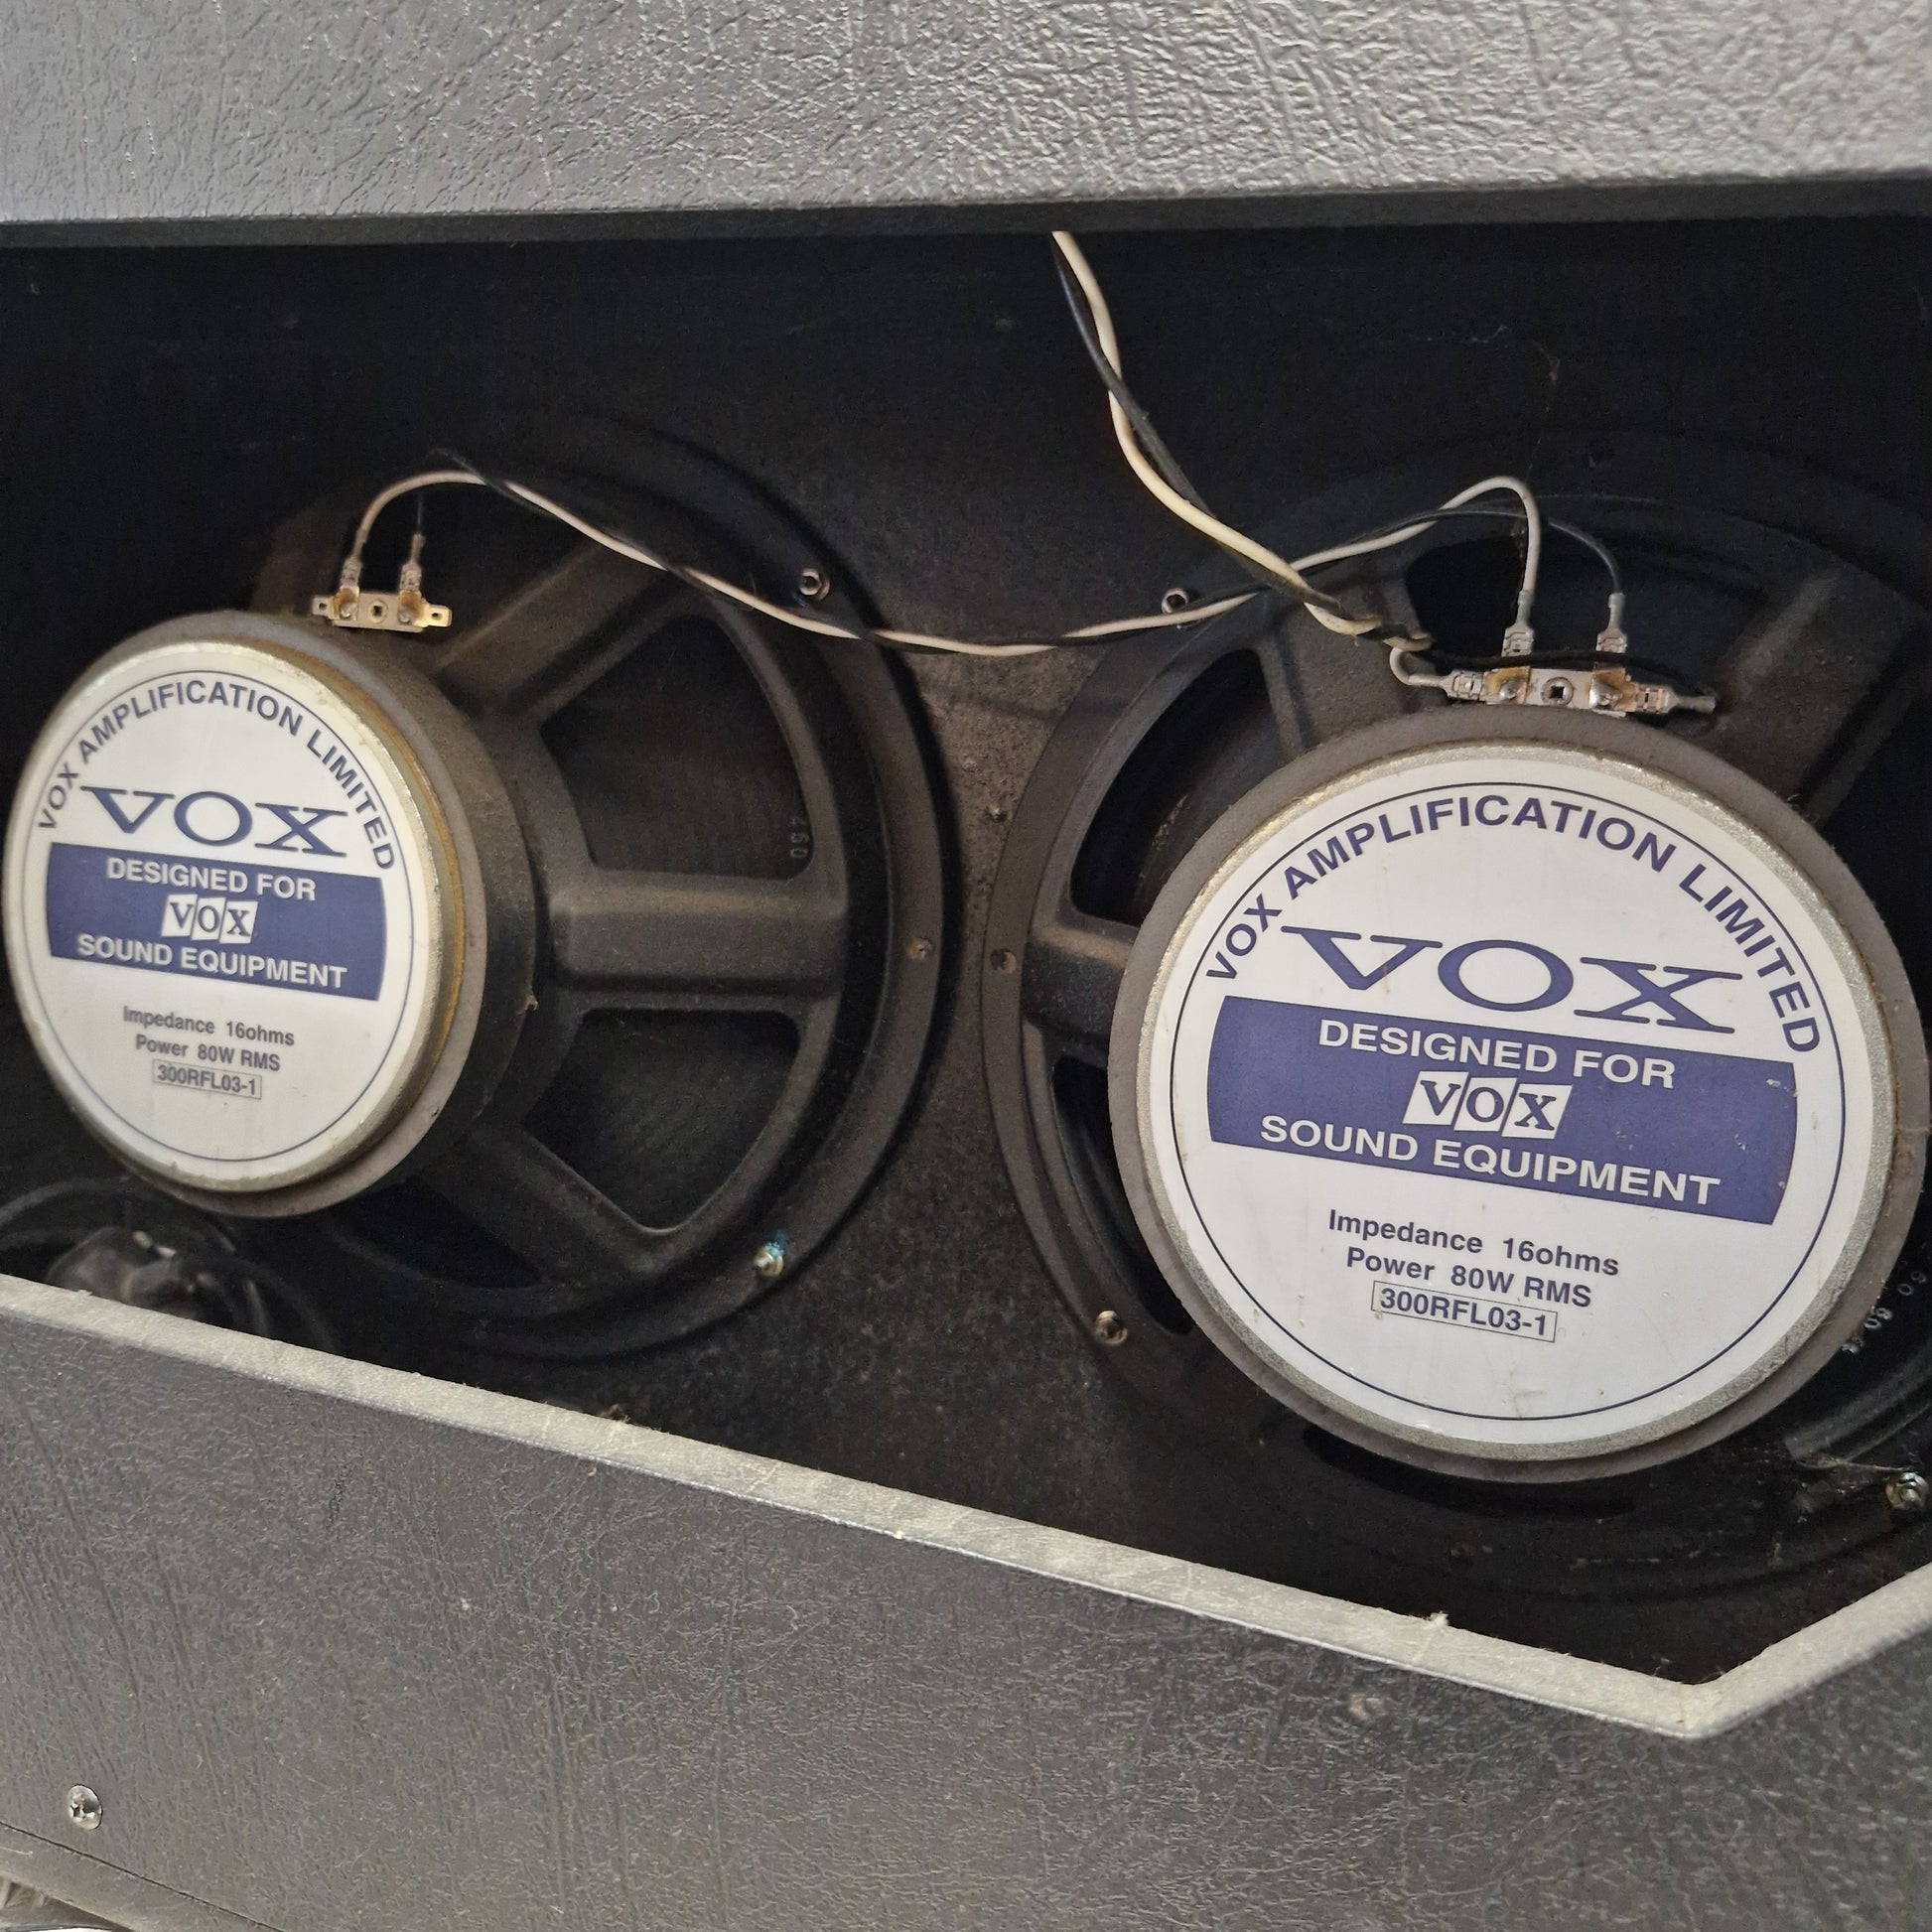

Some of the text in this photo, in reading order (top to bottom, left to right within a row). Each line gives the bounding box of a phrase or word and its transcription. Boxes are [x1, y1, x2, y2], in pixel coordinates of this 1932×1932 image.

[38, 679, 395, 871] VOX AMPLIFICATION LIMITED
[79, 785, 347, 858] VOX
[106, 857, 317, 901] DESIGNED FOR
[167, 898, 253, 940] VOX
[1205, 793, 1821, 1053] VOX AMPLIFICATION LIMITED
[77, 933, 348, 989] SOUND EQUIPMENT
[1282, 925, 1742, 1035] VOX
[123, 1006, 295, 1046] Impedance 16ohms
[135, 1034, 281, 1072] Power 80W RMS
[1318, 1019, 1676, 1089] DESIGNED FOR
[156, 1063, 257, 1097] 300RFL03-1
[1414, 1076, 1563, 1134] VOX
[1260, 1115, 1722, 1210] SOUND EQUIPMENT
[1328, 1208, 1619, 1277] Impedance 16ohms
[1346, 1246, 1591, 1309] Power 80W RMS
[1380, 1286, 1547, 1337] 300RFL03-1
